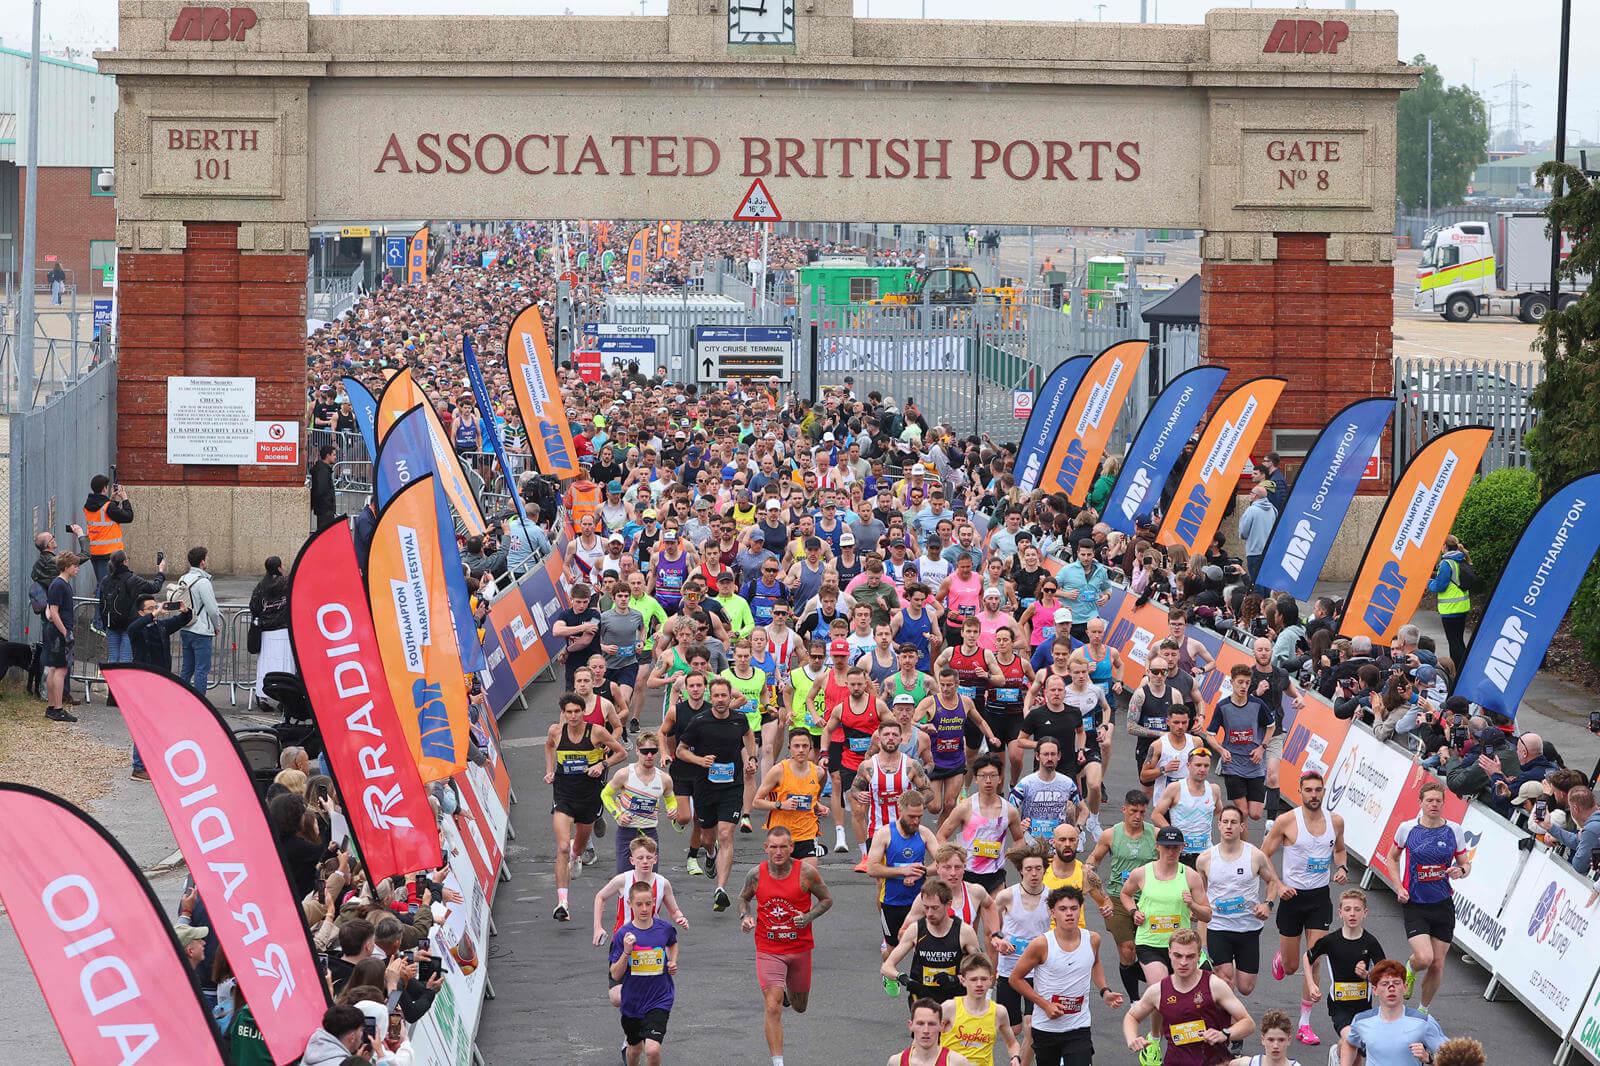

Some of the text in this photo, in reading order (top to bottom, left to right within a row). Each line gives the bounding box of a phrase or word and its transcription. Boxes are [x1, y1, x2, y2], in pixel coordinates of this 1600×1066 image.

[169, 7, 257, 41] ABP
[1262, 19, 1349, 54] ABP
[168, 128, 259, 152] BERTH
[374, 132, 1142, 183] ASSOCIATED BRITISH PORTS
[1266, 140, 1341, 163] GATE
[193, 158, 231, 180] 101
[1317, 169, 1329, 191] 8
[526, 336, 538, 366] FESTIVAL
[617, 325, 650, 333] Security
[525, 368, 542, 414] SOUTHAMPTON
[1038, 376, 1068, 448] SOUTHAMPTON
[1078, 385, 1100, 432] SOUTHAMPTON
[1092, 363, 1121, 430] MARATHON FESTIVAL
[539, 420, 573, 469] ABP
[1122, 386, 1194, 521] ABP SOUTHAMPTON
[1203, 427, 1231, 477] SOUTHAMPTON
[1218, 401, 1256, 469] MARATHON FESTIVAL
[1055, 438, 1088, 497] ABP
[1175, 484, 1208, 549] ABP
[1281, 423, 1359, 582] ABP SOUTHAMPTON
[1395, 490, 1425, 552] SOUTHAMPTON
[1415, 458, 1455, 541] MARATHON FESTIVAL
[406, 533, 420, 582] FESTIVAL
[1363, 560, 1408, 637] ABP
[1484, 498, 1587, 694] ABP SOUTHAMPTON
[397, 586, 419, 667] SOUTHAMPTON
[412, 678, 456, 764] ABP
[1034, 791, 1061, 802] ABP
[1356, 757, 1389, 791] Southampton
[1468, 908, 1506, 951] SHIPPING
[1548, 923, 1571, 960] Survey
[1559, 899, 1589, 938] Ordnance
[1530, 970, 1541, 986] SEE
[955, 1025, 992, 1044] Sophie's
